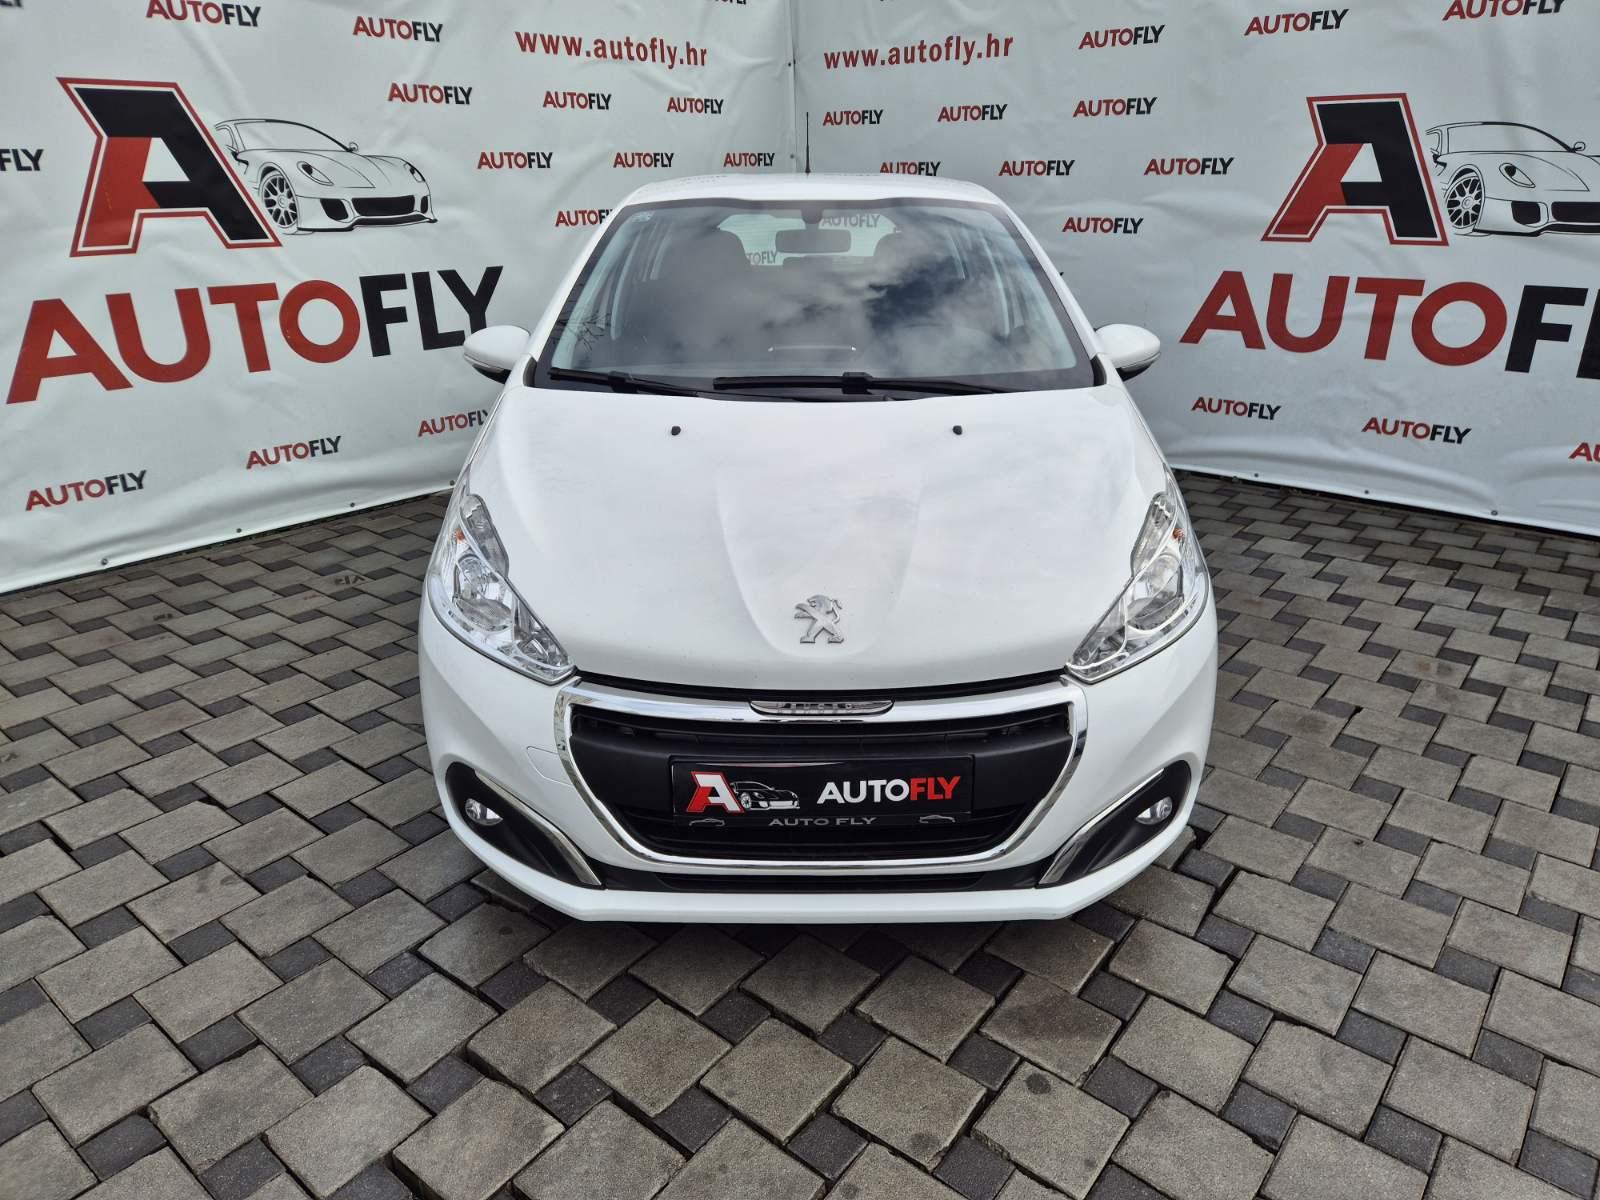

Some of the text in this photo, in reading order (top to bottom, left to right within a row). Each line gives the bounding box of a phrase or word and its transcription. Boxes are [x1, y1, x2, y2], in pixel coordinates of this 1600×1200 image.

[146, 0, 261, 27] AUTOFLY
[1442, 0, 1564, 21] AUTOFLY
[353, 16, 443, 42] AUTOFLY
[1244, 9, 1350, 36] AUTOFLY
[1078, 25, 1165, 50] AUTOFLY
[515, 32, 707, 69] www.autofly.hr
[824, 33, 1014, 69] www.autofly.hr
[388, 82, 473, 106] AUTOFLY
[543, 91, 612, 111] AUTOFLY
[667, 97, 724, 115] AUTOFLY
[937, 103, 1008, 122] AUTOFLY
[1072, 97, 1158, 118] AUTOFLY
[823, 109, 884, 126] AUTOFLY
[477, 152, 553, 170] AUTOFLY
[613, 152, 674, 169] AUTOFLY
[724, 153, 775, 168] AUTOFLY
[880, 160, 941, 177] AUTOFLY
[998, 160, 1075, 177] AUTOFLY
[1144, 157, 1235, 176] AUTOFLY
[555, 208, 613, 227] AUTOF
[1062, 217, 1144, 235] AUTOFLY
[6, 265, 504, 405] AUTOFLY
[1192, 396, 1282, 421] AUTOFLY
[1361, 416, 1473, 445] AUTOFLY
[246, 435, 342, 470] AUTOFLY
[26, 469, 147, 511] AUTOFLY
[816, 775, 961, 805] AUTOFLY
[768, 816, 877, 827] AUTO FLY
